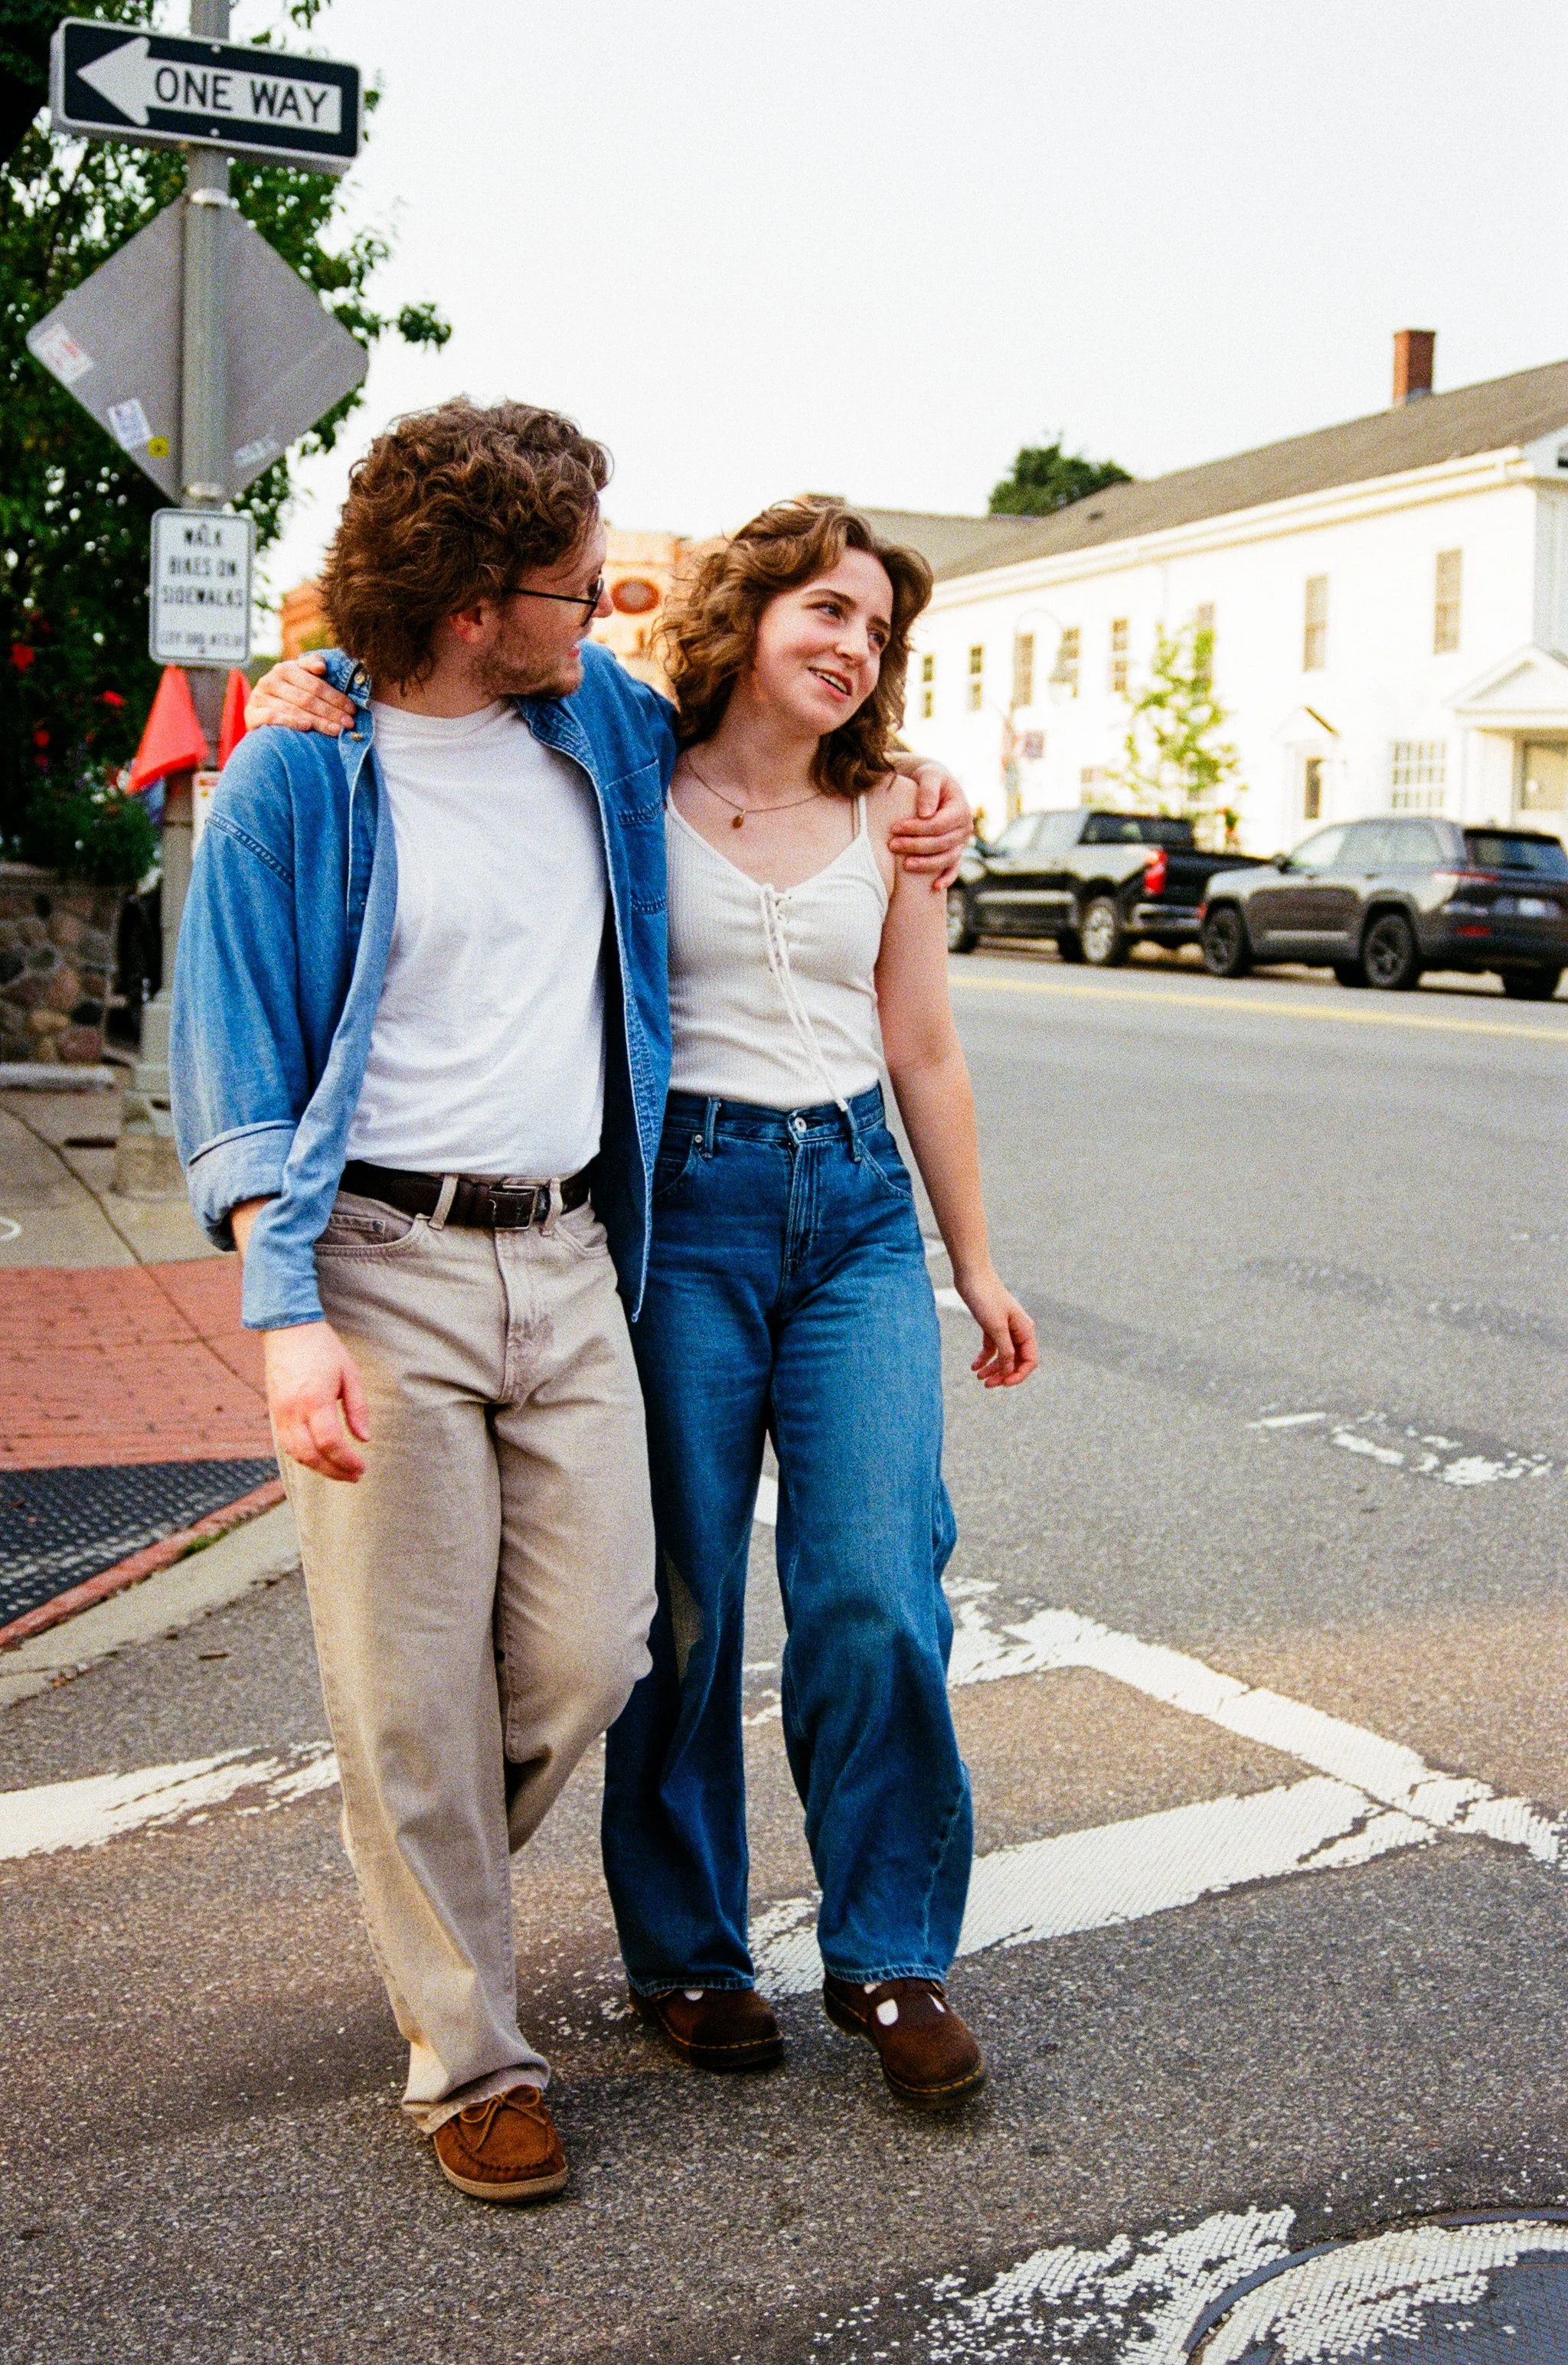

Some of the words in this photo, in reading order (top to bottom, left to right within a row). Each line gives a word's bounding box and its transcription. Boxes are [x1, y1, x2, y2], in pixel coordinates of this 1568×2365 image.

[155, 67, 232, 111] ONE
[250, 79, 327, 122] WAY
[184, 528, 221, 547] WALK
[217, 559, 236, 577] ON
[162, 585, 243, 607] SIDEWALKS
